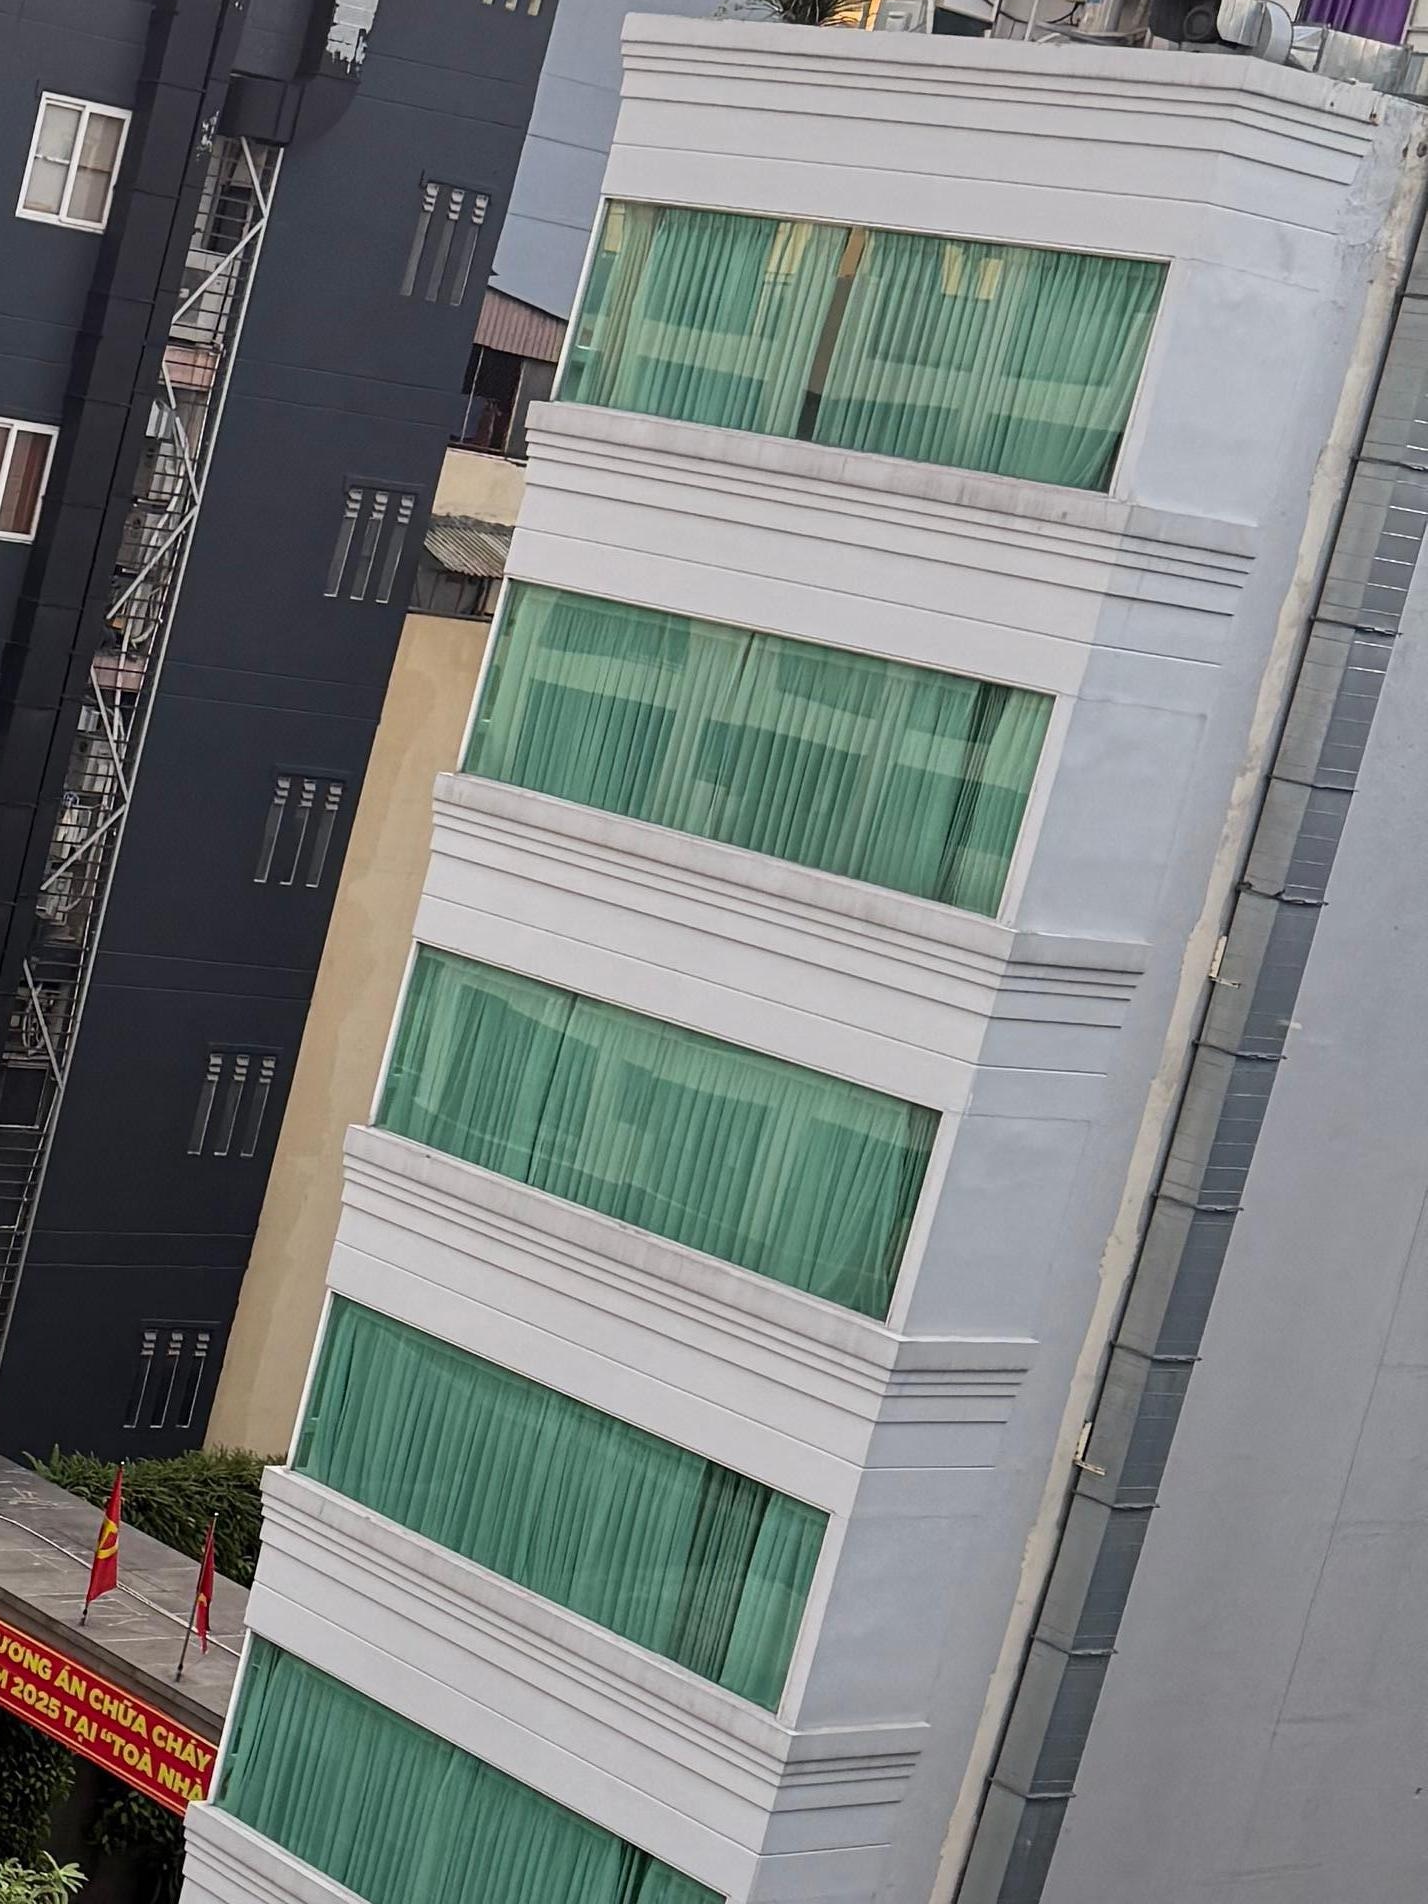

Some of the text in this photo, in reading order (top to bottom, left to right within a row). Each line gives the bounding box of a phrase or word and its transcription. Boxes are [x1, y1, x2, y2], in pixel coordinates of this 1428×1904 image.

[10, 1677, 62, 1720] 2025
[63, 1705, 98, 1744] TẠI
[157, 1762, 205, 1801] NHÀ
[54, 1667, 87, 1701] ÁN
[89, 1689, 148, 1738] CHỮA
[152, 1725, 212, 1773] CHÁY
